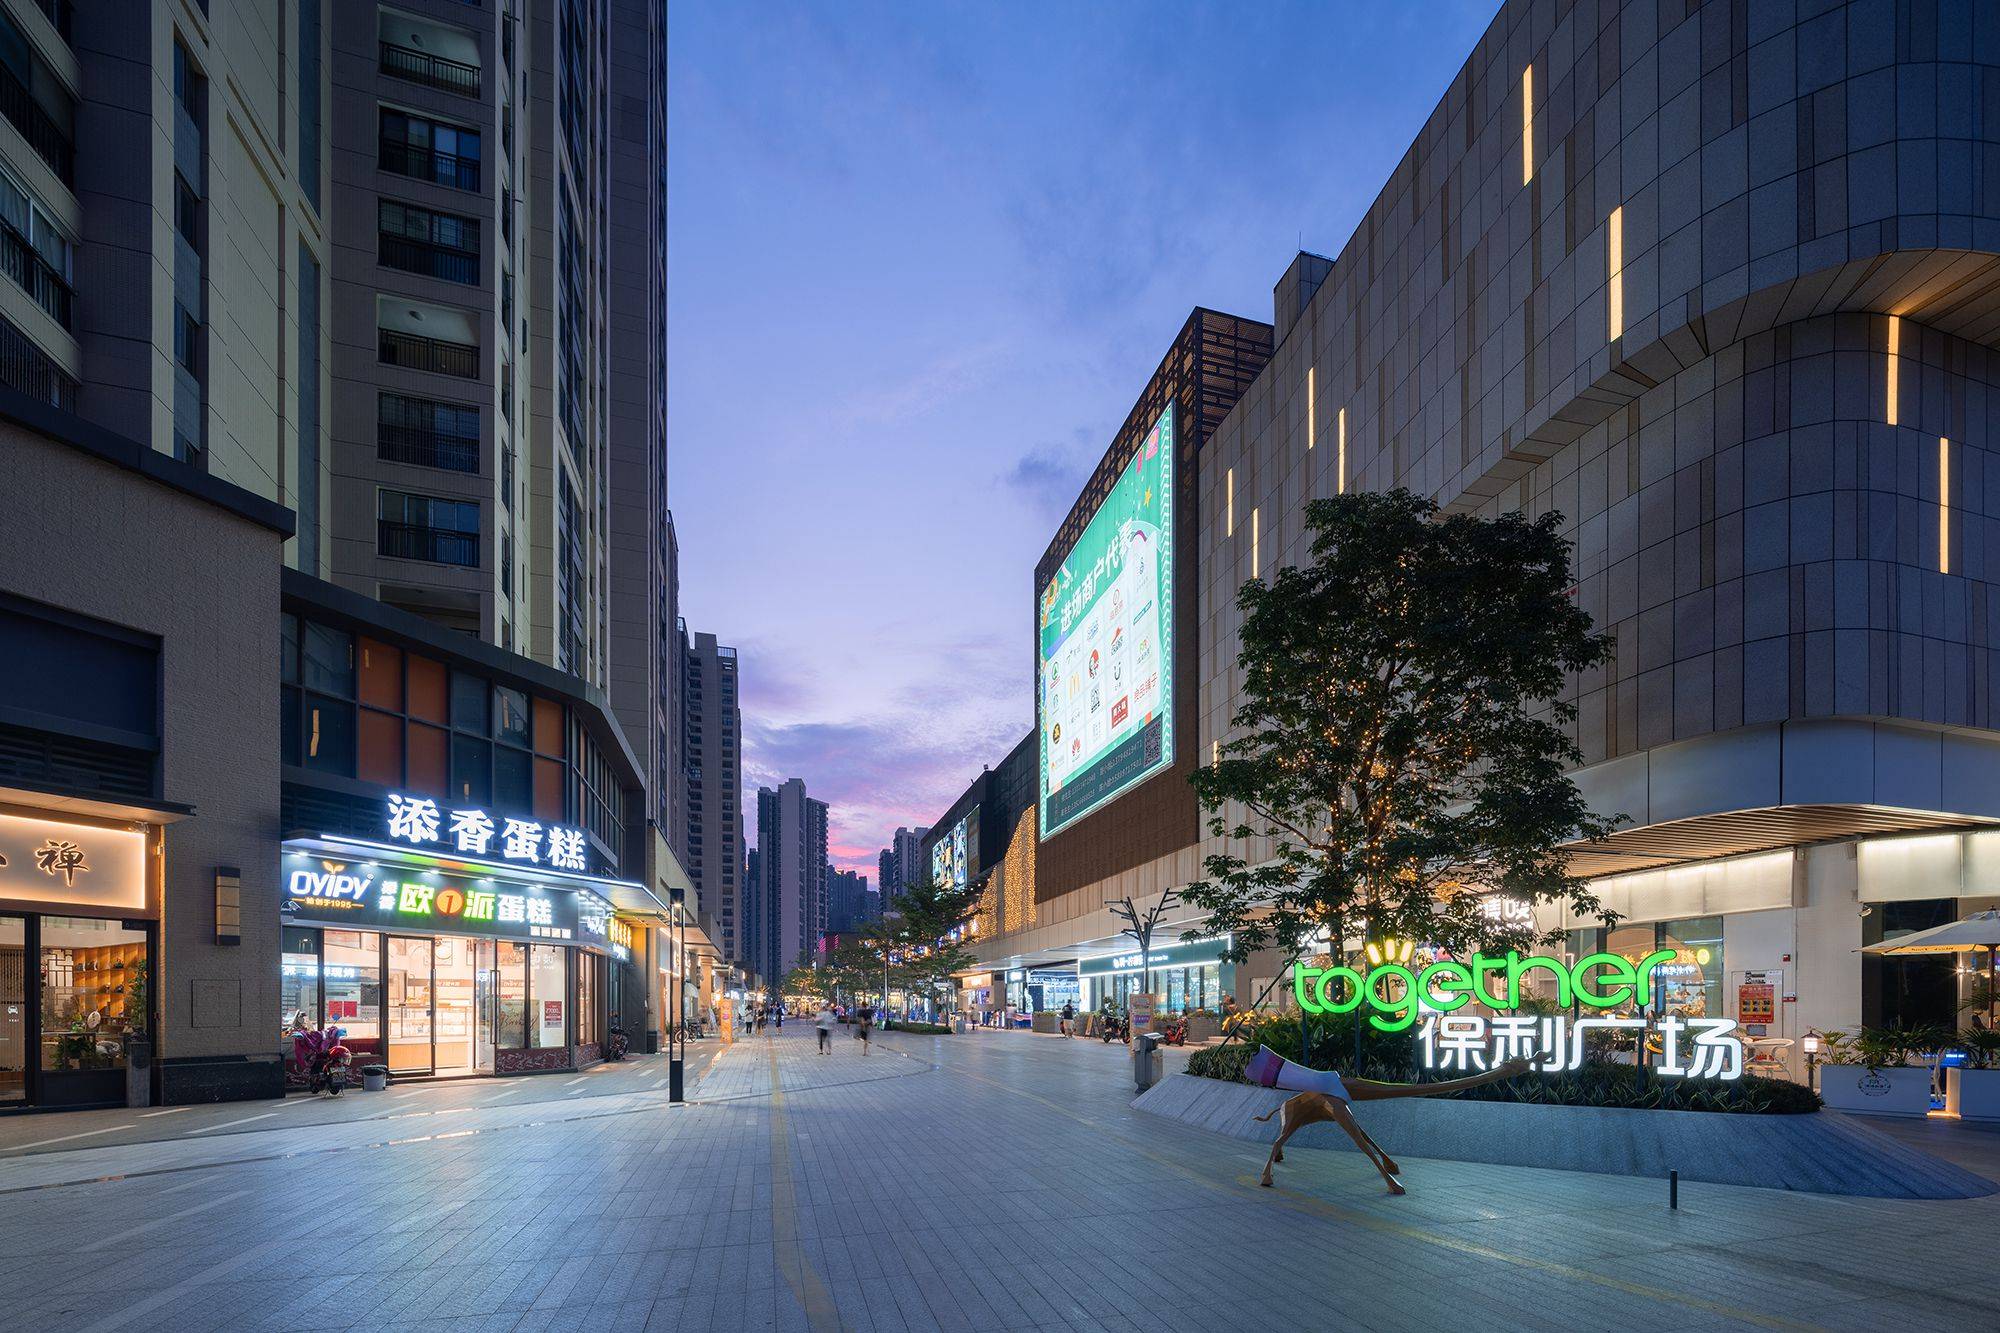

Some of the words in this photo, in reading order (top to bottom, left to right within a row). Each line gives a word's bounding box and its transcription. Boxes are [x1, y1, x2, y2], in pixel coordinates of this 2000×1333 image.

[387, 794, 586, 870] 添香蛋糕
[1293, 947, 1678, 1032] together
[1419, 1014, 1742, 1082] 保利广场
